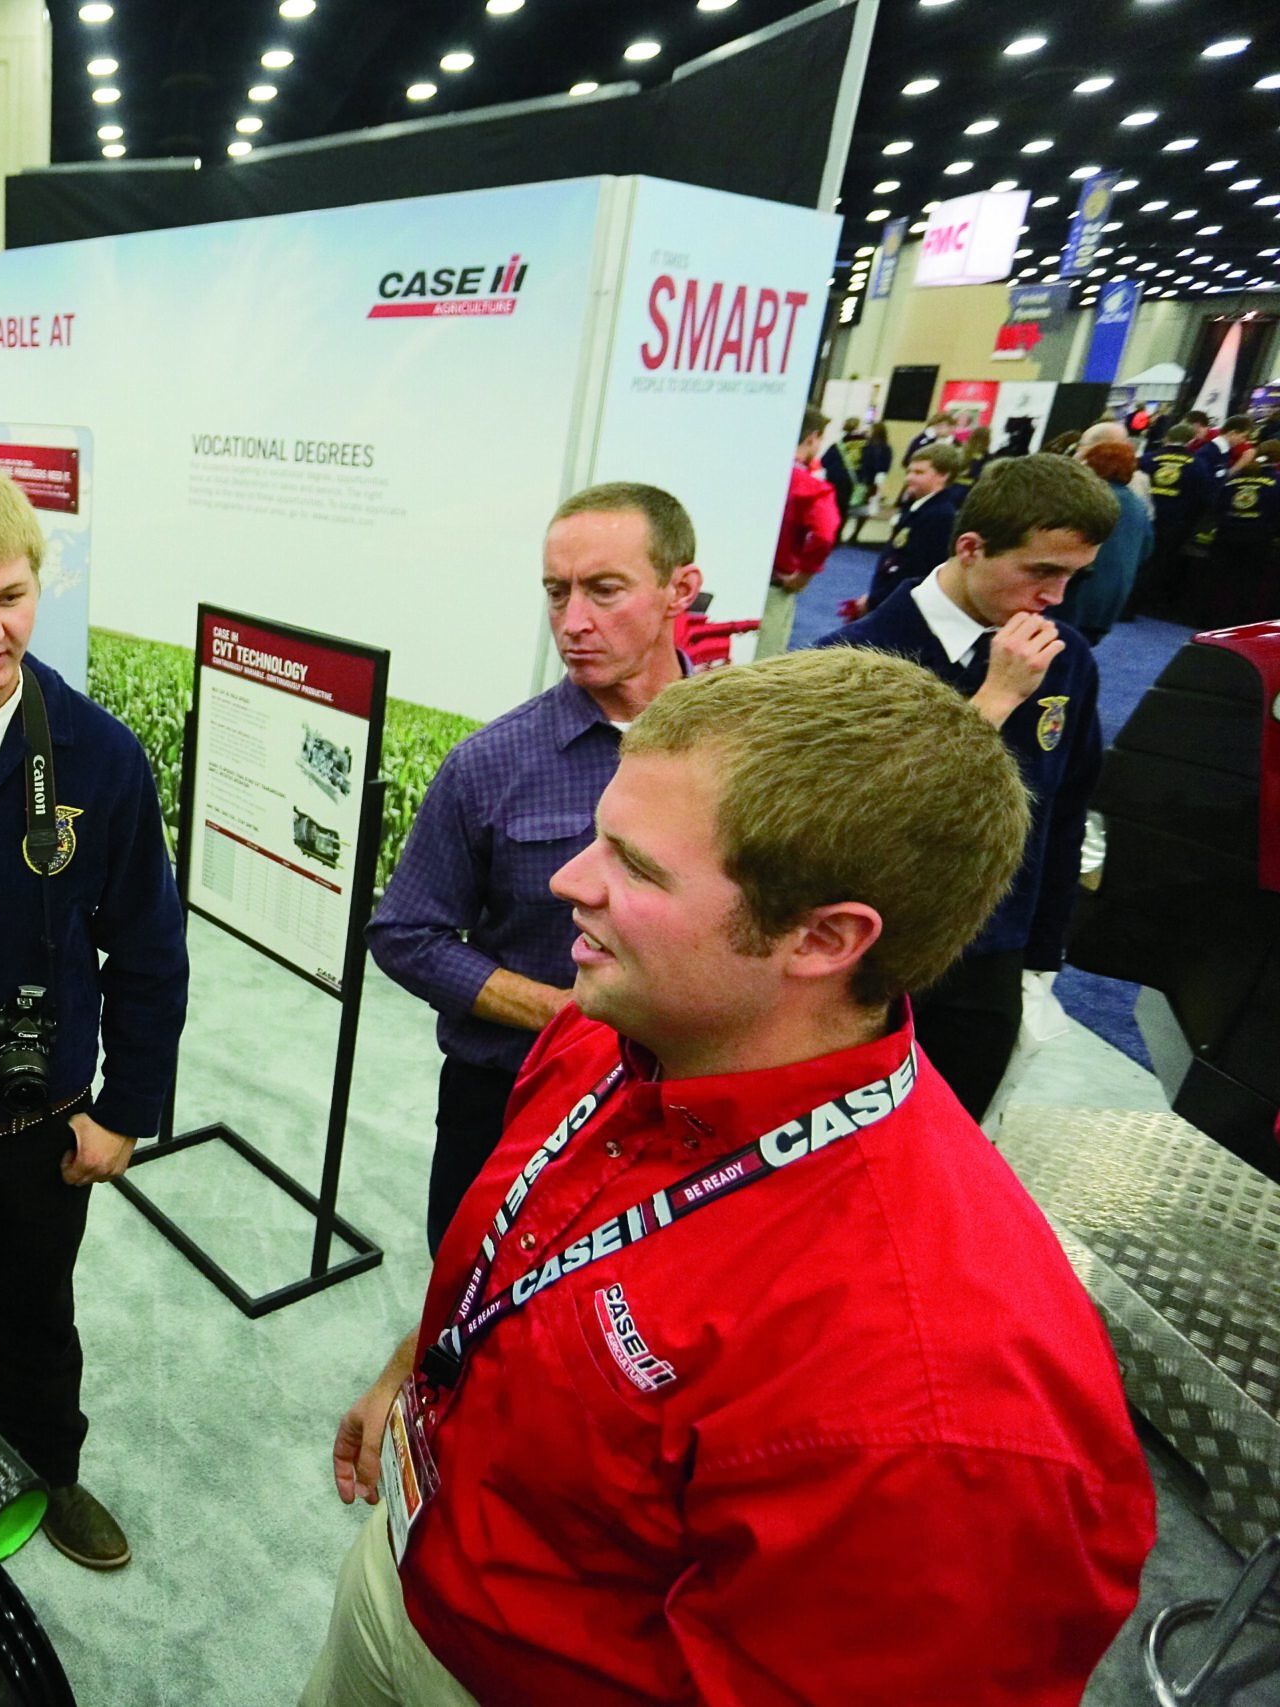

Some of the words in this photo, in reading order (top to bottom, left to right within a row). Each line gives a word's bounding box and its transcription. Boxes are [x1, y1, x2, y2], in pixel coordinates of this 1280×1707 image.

[378, 266, 485, 299] CASE
[431, 300, 513, 315] AGRICULTURE
[640, 274, 808, 375] SMART
[50, 313, 75, 346] AT
[191, 433, 288, 462] VOCATIONAL
[294, 440, 375, 468] DEGREES
[212, 626, 230, 641] CASE
[212, 638, 234, 660] CVT
[236, 644, 308, 682] TECHNOLOGY
[32, 754, 47, 815] Canon
[759, 1053, 914, 1168] CASE
[505, 1094, 597, 1218] CASE
[512, 1217, 622, 1305] CASE
[683, 1183, 704, 1202] BE
[704, 1161, 745, 1192] READY
[472, 1266, 483, 1284] BE
[458, 1283, 478, 1319] READY
[468, 1321, 478, 1334] BE
[477, 1300, 501, 1325] READY
[606, 1283, 647, 1357] CASE
